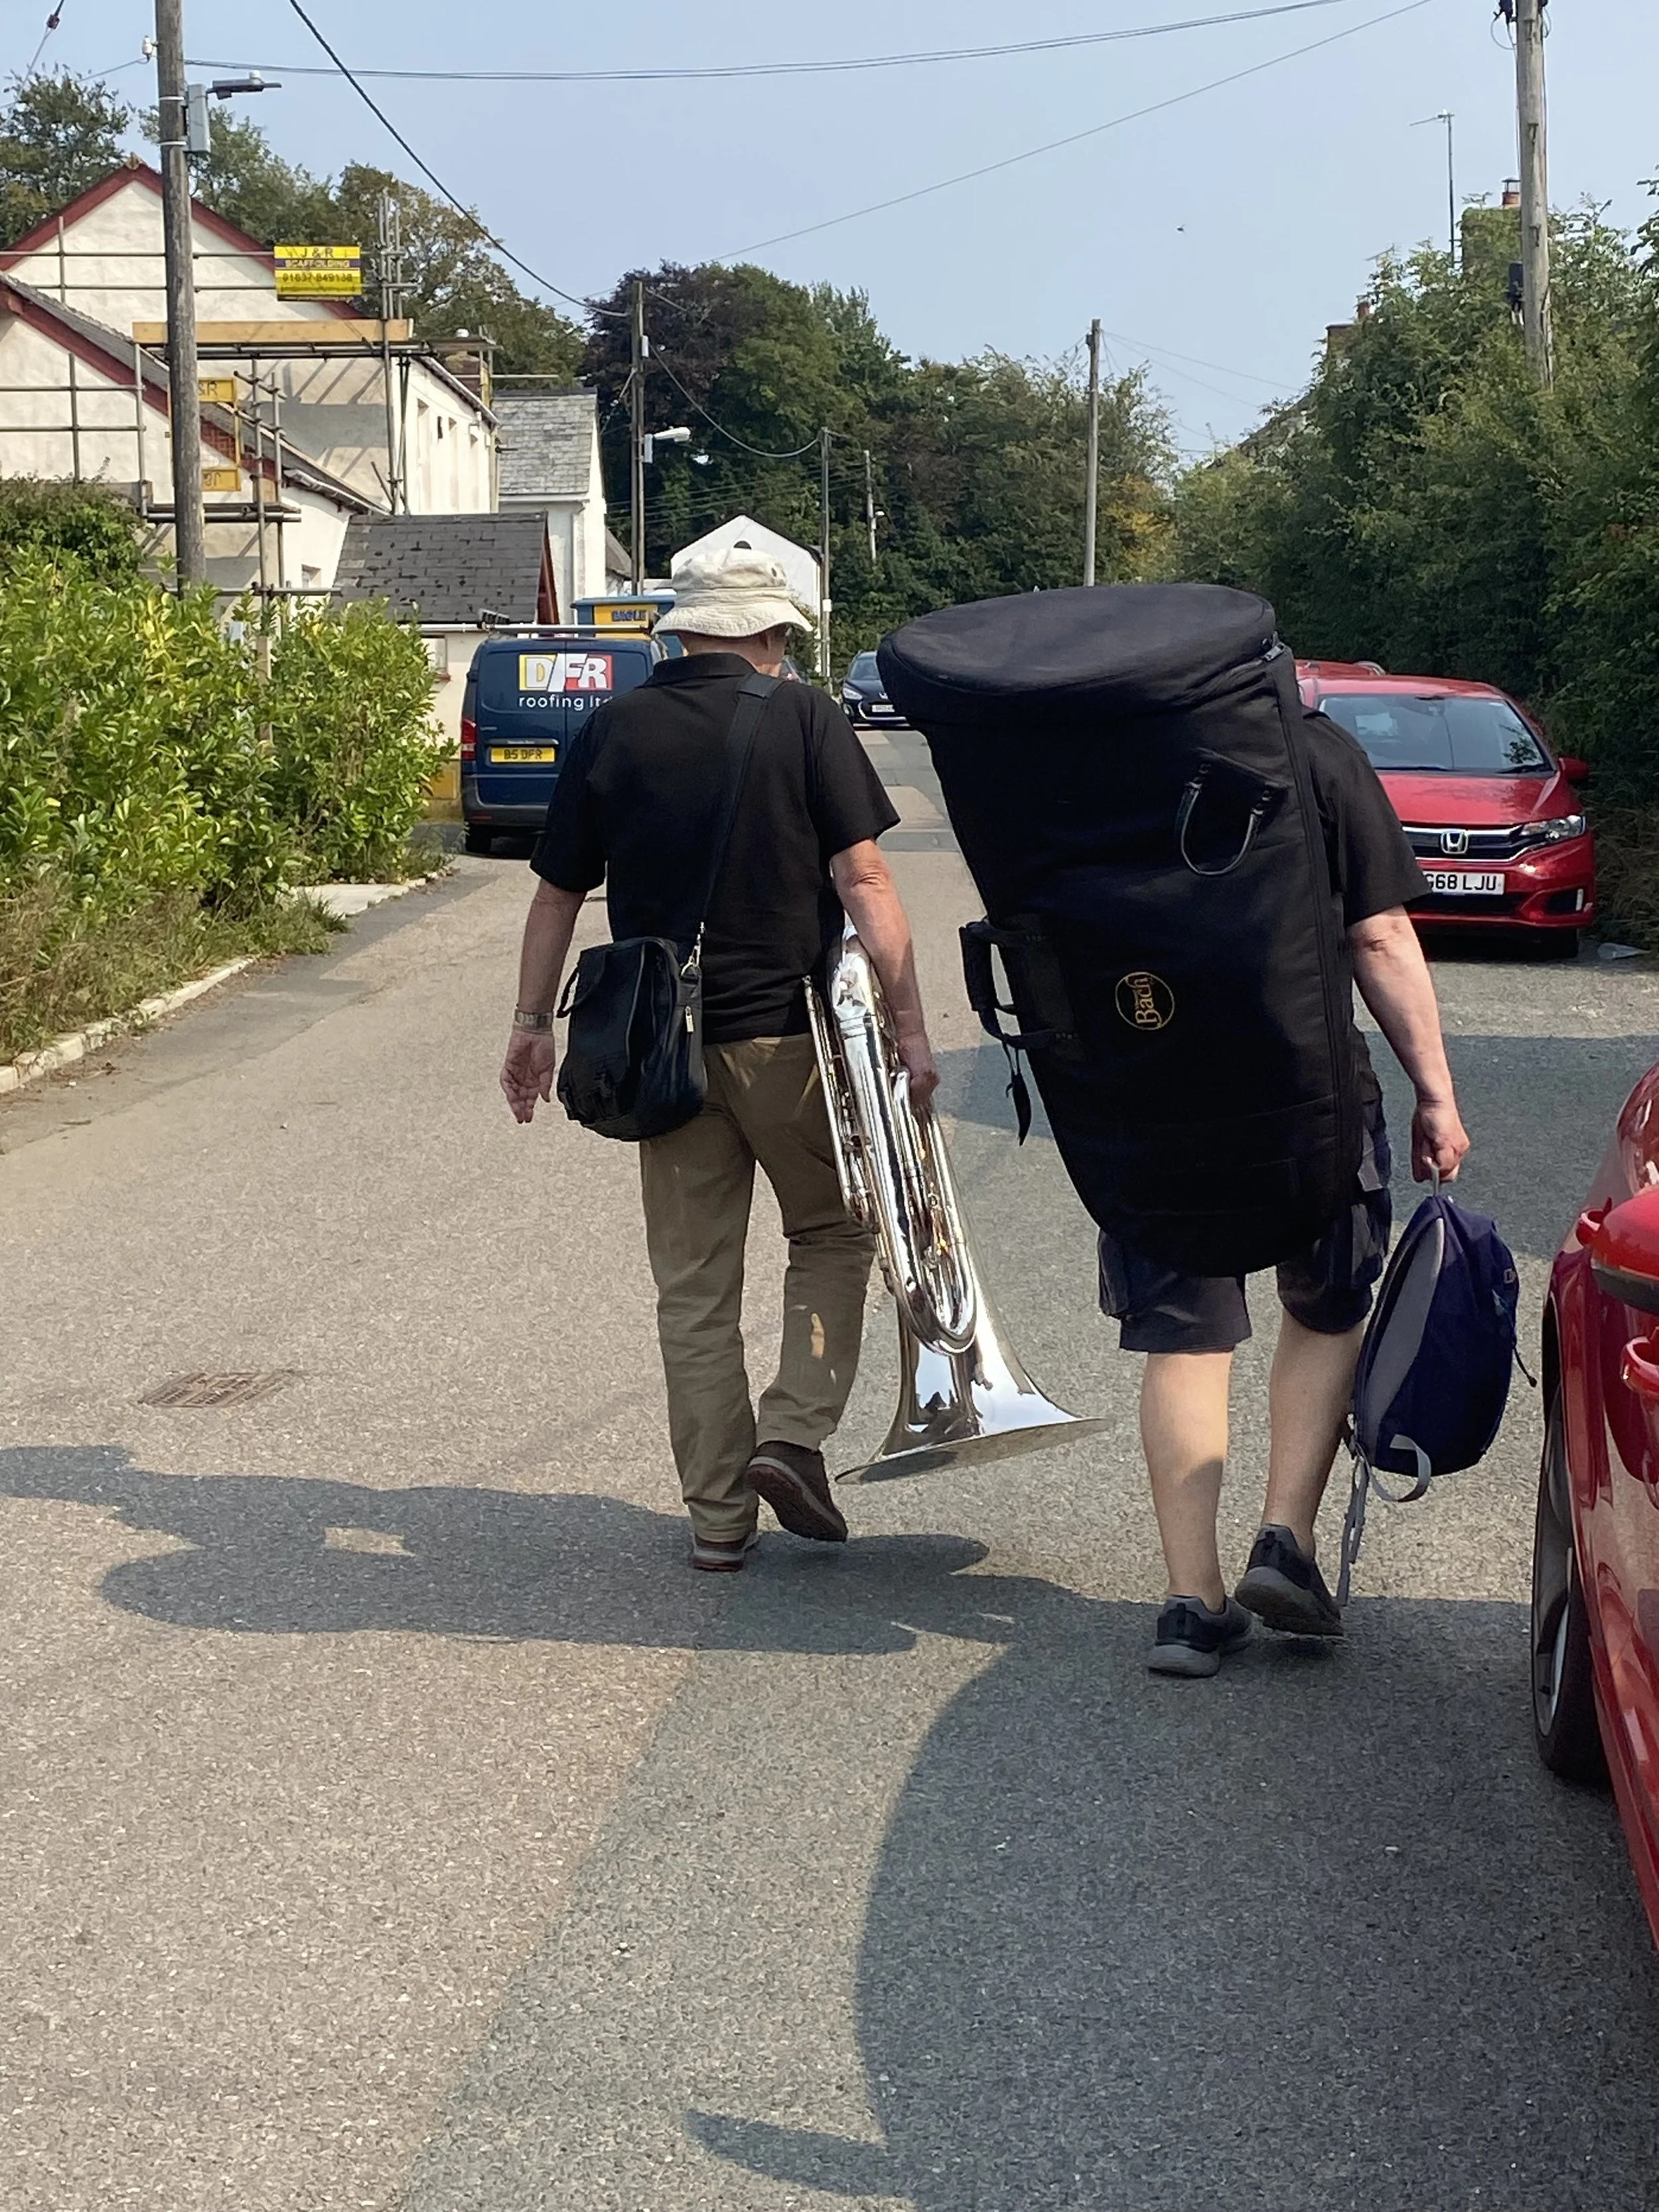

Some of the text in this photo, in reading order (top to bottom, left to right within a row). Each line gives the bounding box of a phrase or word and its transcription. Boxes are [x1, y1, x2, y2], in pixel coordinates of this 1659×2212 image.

[301, 247, 334, 258] J & R
[524, 653, 609, 692] DFR
[518, 694, 584, 711] roofing
[520, 749, 542, 760] DFR
[1463, 875, 1497, 891] LJU
[1126, 977, 1162, 1027] Bach
